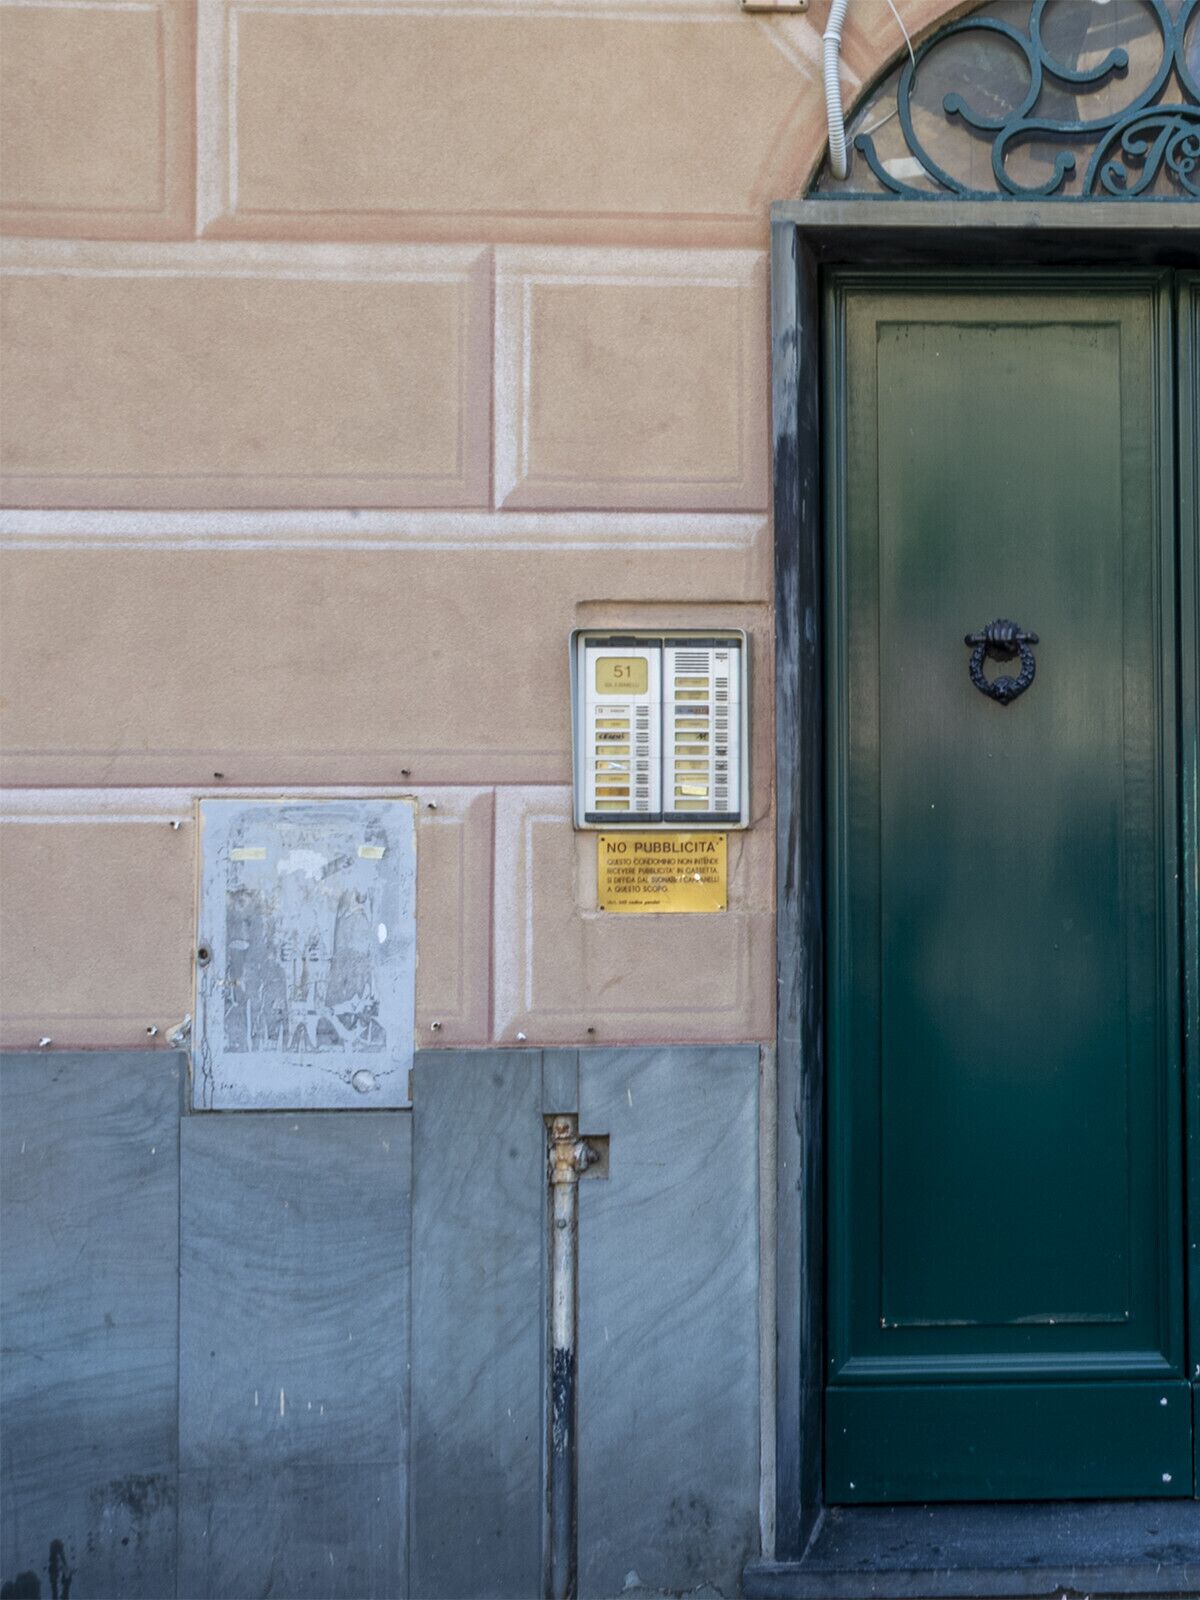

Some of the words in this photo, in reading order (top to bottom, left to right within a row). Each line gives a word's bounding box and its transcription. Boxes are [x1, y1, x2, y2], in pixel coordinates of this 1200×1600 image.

[613, 665, 631, 678] 51
[607, 842, 627, 853] NO
[607, 858, 632, 866] QUESTO
[633, 858, 676, 866] CONDOMINIO
[677, 858, 693, 866] NON
[694, 858, 719, 866] INTENDE
[607, 867, 636, 875] RICEVERE
[677, 867, 684, 875] IN
